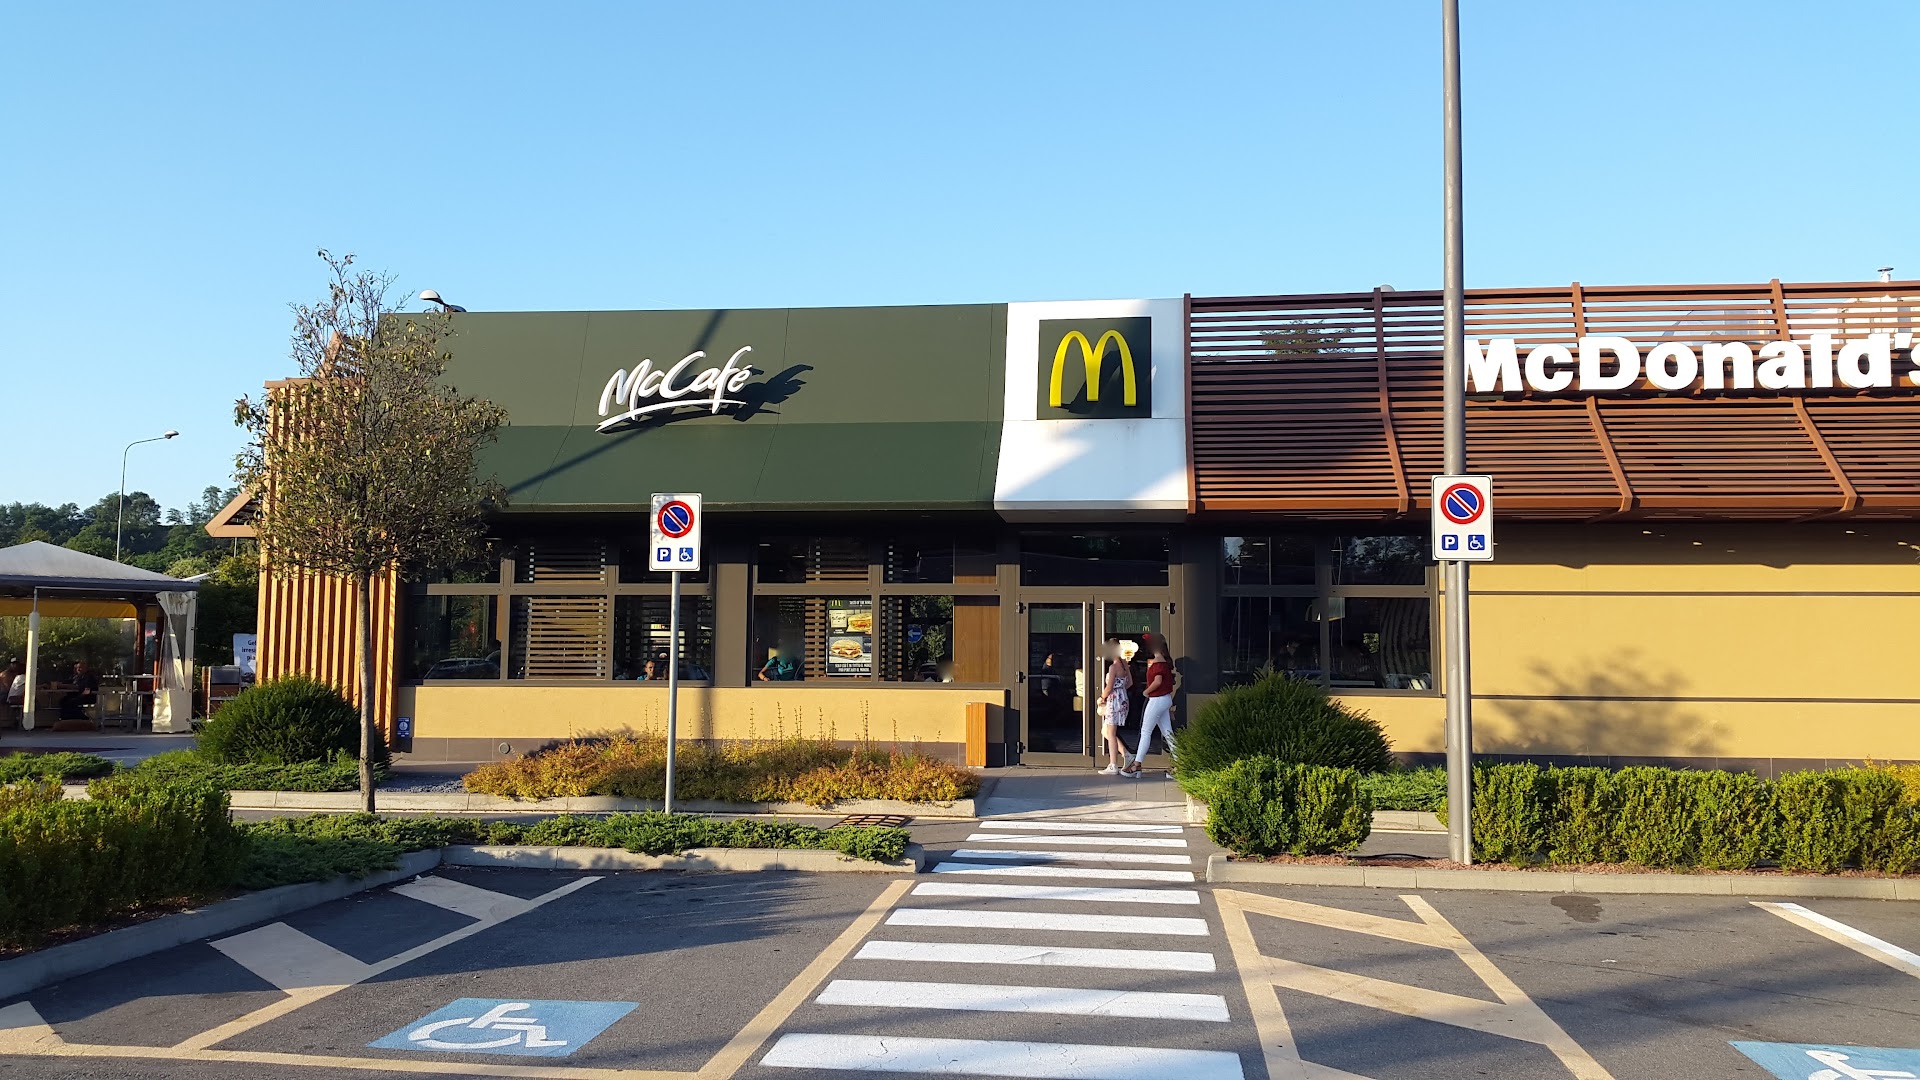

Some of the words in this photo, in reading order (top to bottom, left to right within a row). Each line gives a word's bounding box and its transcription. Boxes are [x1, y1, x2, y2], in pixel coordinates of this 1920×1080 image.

[1464, 333, 1920, 392] McDonald'
[598, 346, 753, 421] McCafé
[659, 549, 669, 561] P
[1444, 536, 1455, 549] P
